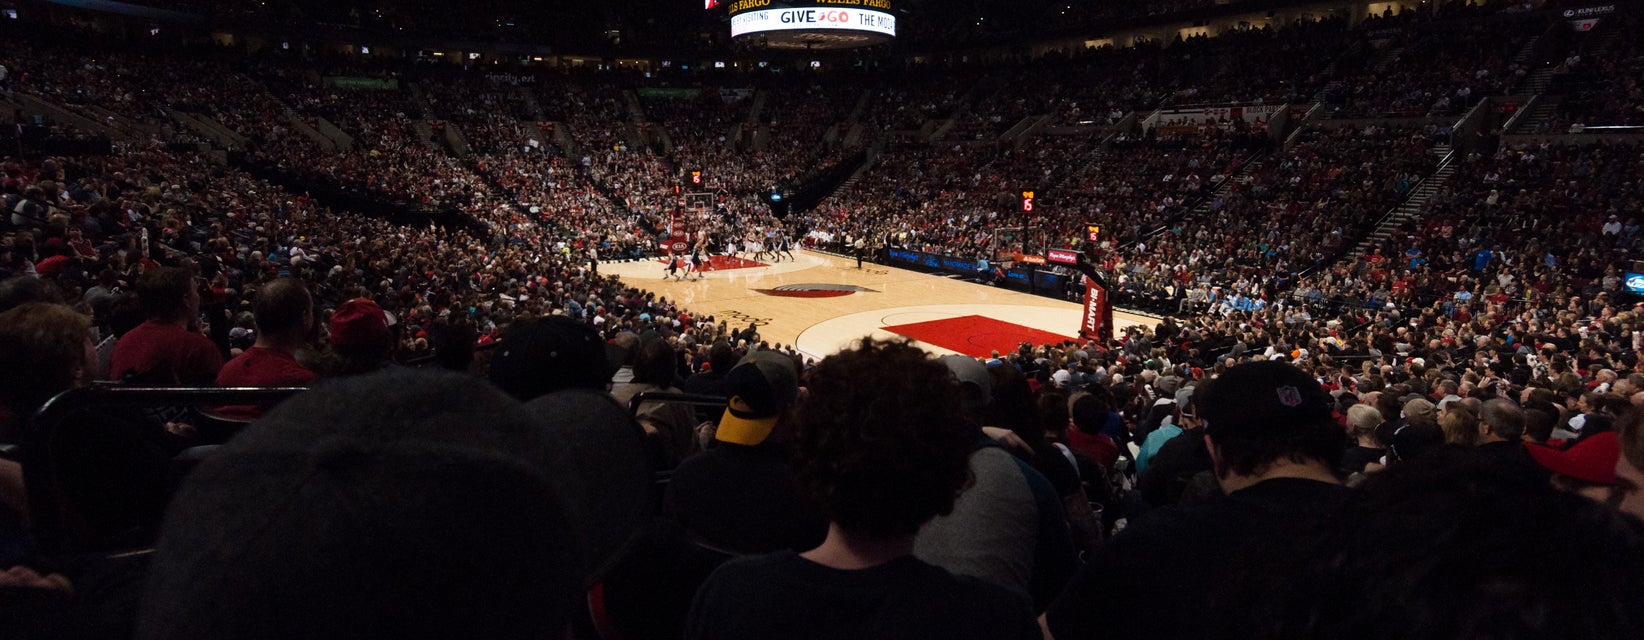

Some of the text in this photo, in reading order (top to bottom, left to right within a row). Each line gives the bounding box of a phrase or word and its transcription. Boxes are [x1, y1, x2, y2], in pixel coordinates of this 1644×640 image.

[739, 0, 771, 10] FARGO
[863, 0, 891, 10] FARGO
[781, 10, 849, 23] GIVE GO
[859, 13, 875, 27] THE
[1024, 199, 1032, 211] 15
[1087, 288, 1098, 332] BI-MART
